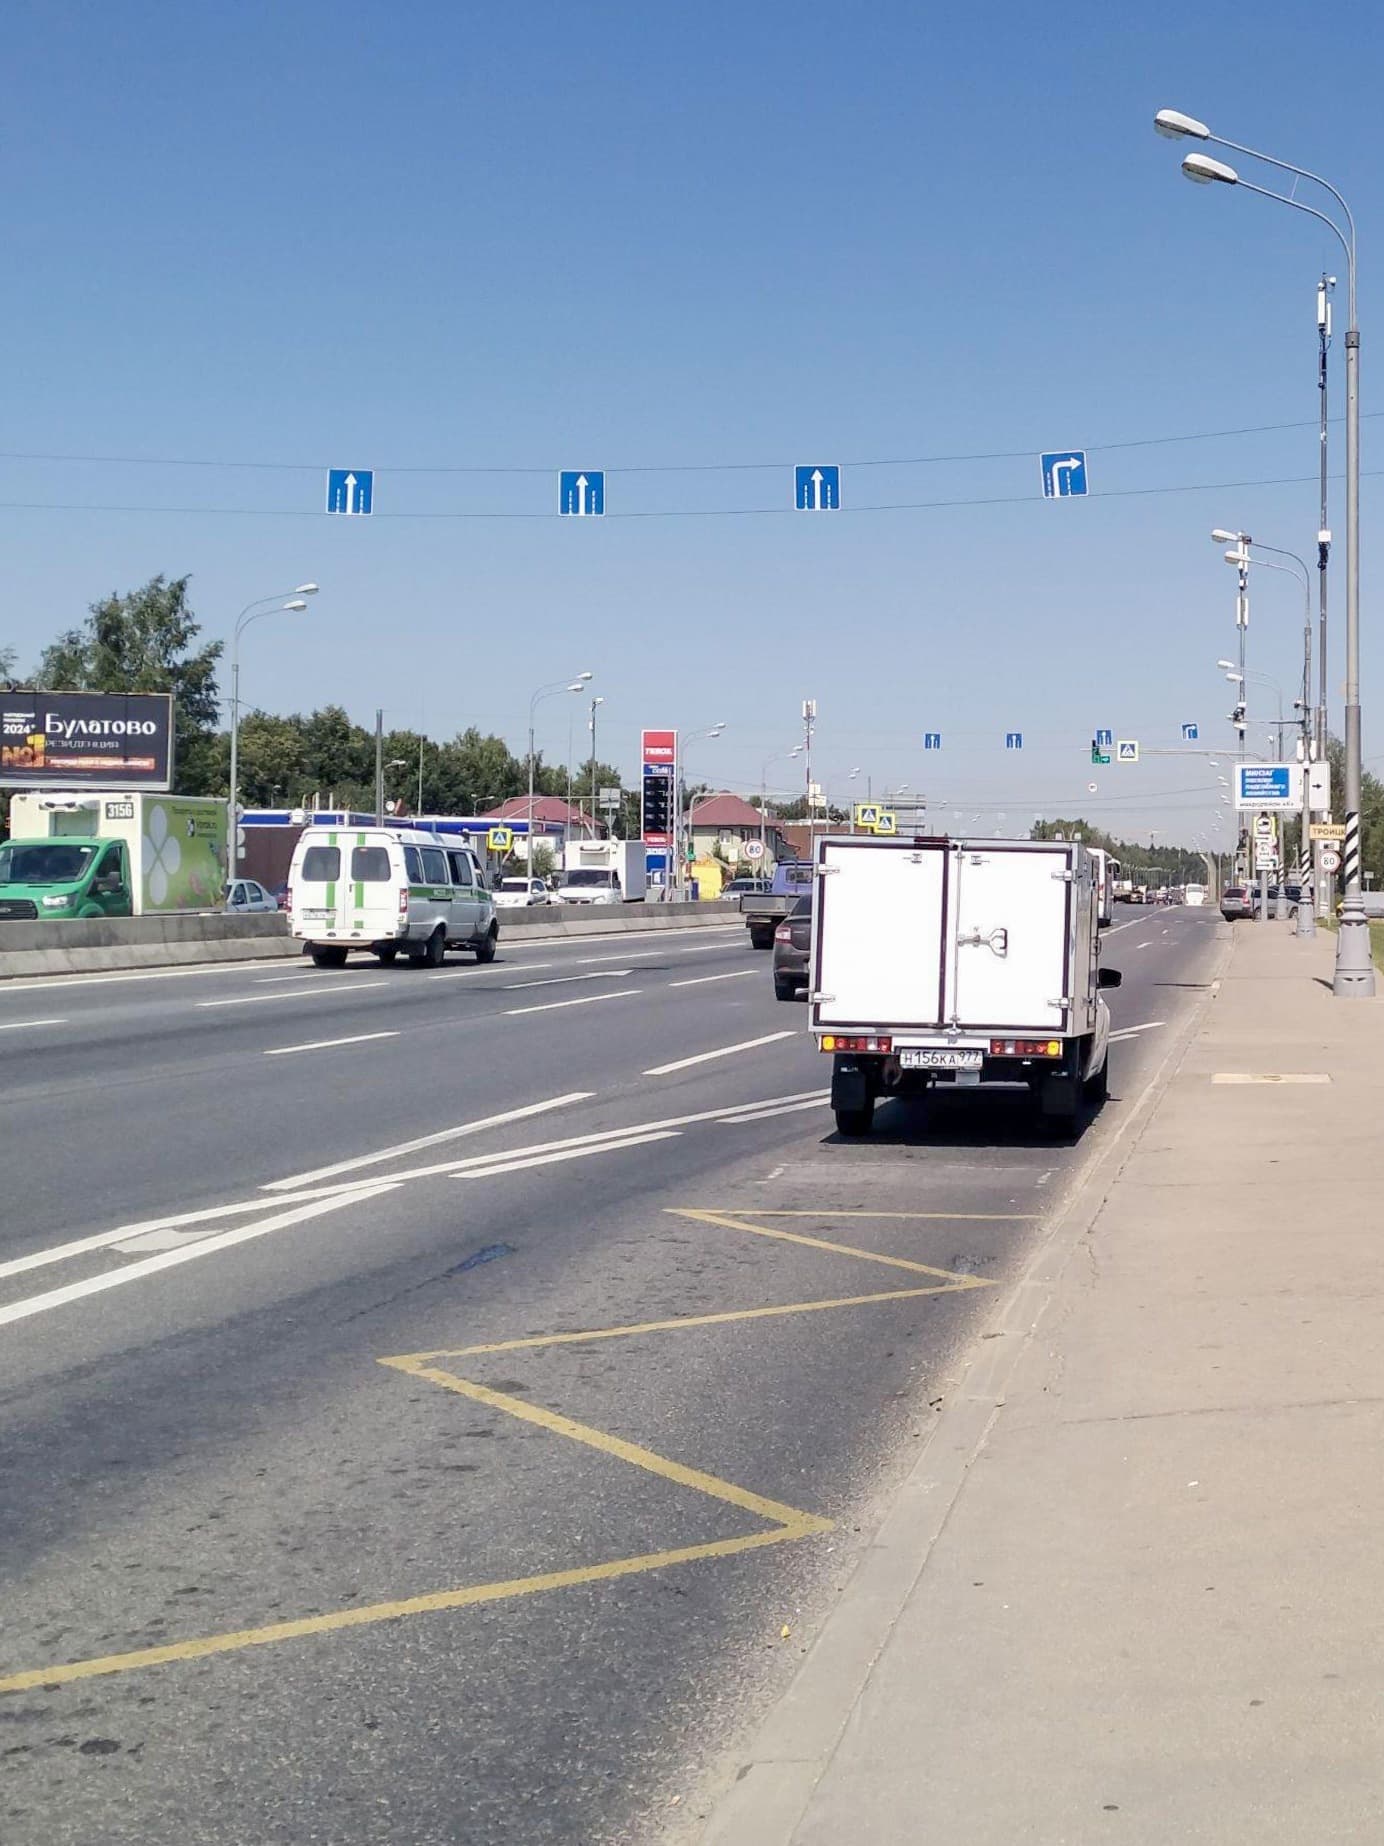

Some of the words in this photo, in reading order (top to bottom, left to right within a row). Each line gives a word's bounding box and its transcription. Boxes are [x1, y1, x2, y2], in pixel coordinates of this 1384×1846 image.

[45, 712, 157, 739] Булатово
[107, 803, 133, 818] 3156
[904, 1051, 956, 1065] Н156КА
